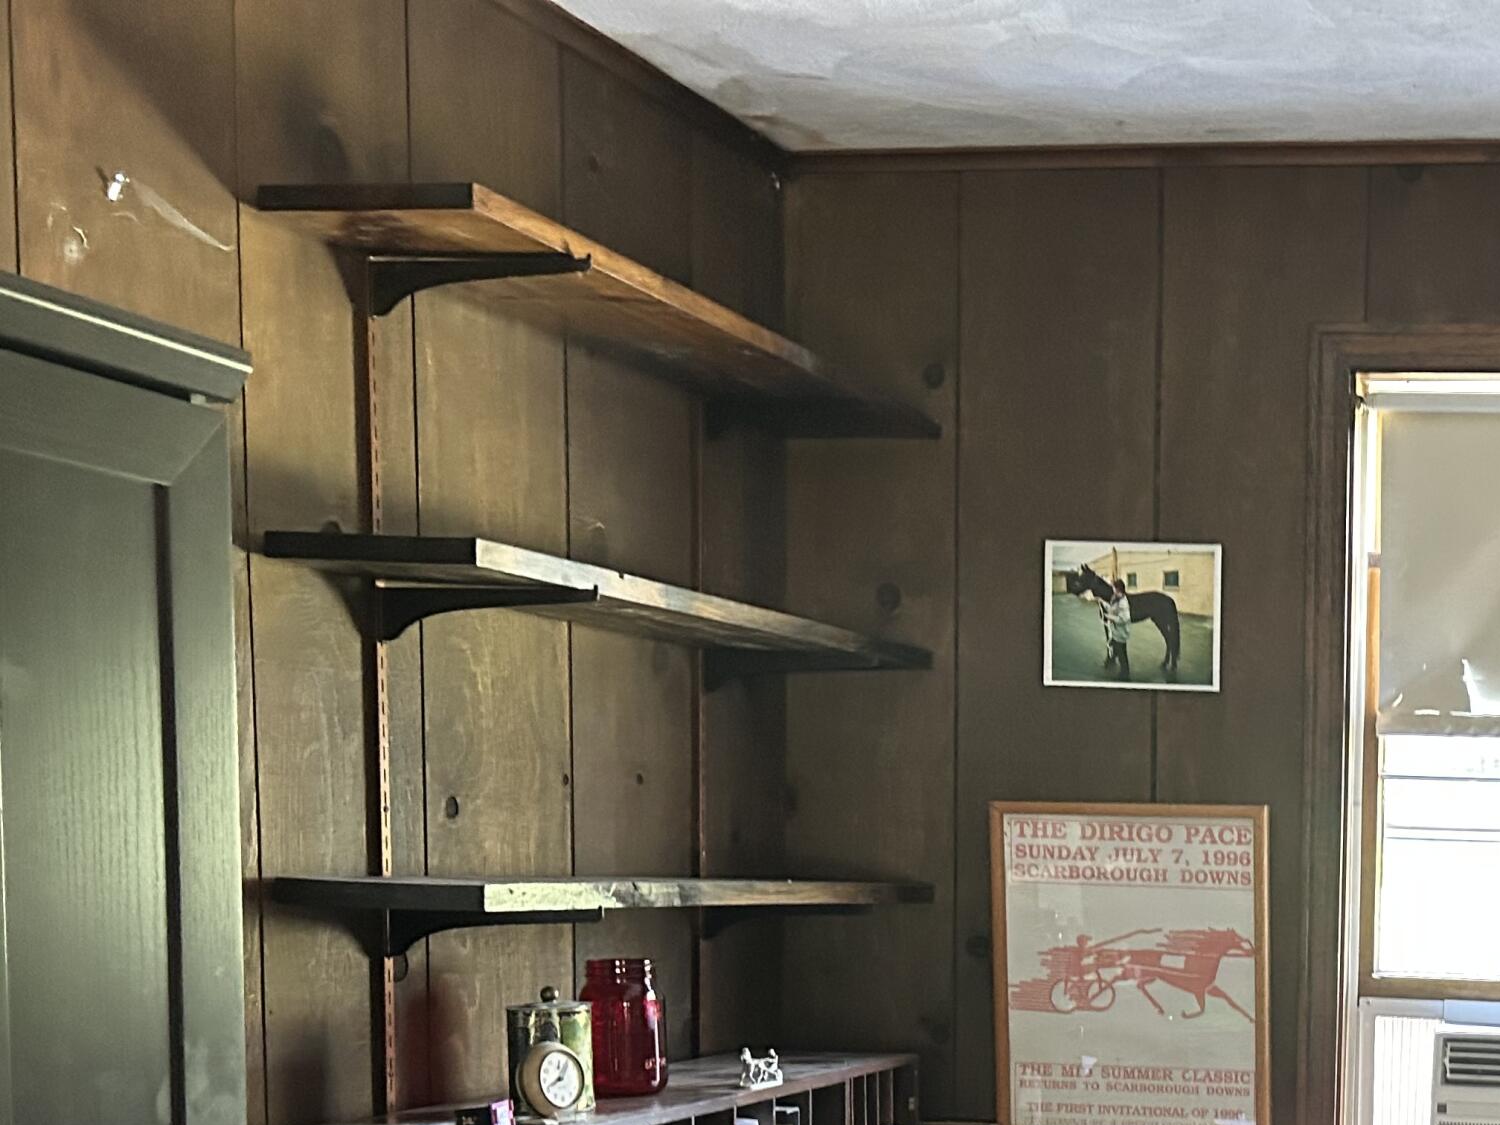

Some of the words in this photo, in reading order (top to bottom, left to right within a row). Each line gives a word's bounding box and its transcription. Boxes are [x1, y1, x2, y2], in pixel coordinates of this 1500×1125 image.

[1014, 819, 1067, 839] THE
[1080, 822, 1174, 844] DIRIGO
[1184, 825, 1252, 846] PACE
[1015, 843, 1099, 863] SUNDAY
[1107, 846, 1162, 864] JULY
[1202, 849, 1252, 868] 1996
[1014, 863, 1169, 884] SCARBOROUGH
[1180, 869, 1252, 887] DOWNS
[1020, 1063, 1053, 1077] THE
[1101, 1065, 1173, 1082] SUMMER
[1181, 1068, 1251, 1085] CLASSIC
[1083, 1080, 1101, 1092] TO
[1105, 1081, 1200, 1096] SCARBOROUGH
[1206, 1085, 1251, 1098] DOWNS
[1027, 1102, 1053, 1114] THE
[1057, 1103, 1094, 1115] FIRST
[1098, 1104, 1188, 1118] INVITATIONAL
[1191, 1107, 1209, 1119] OF
